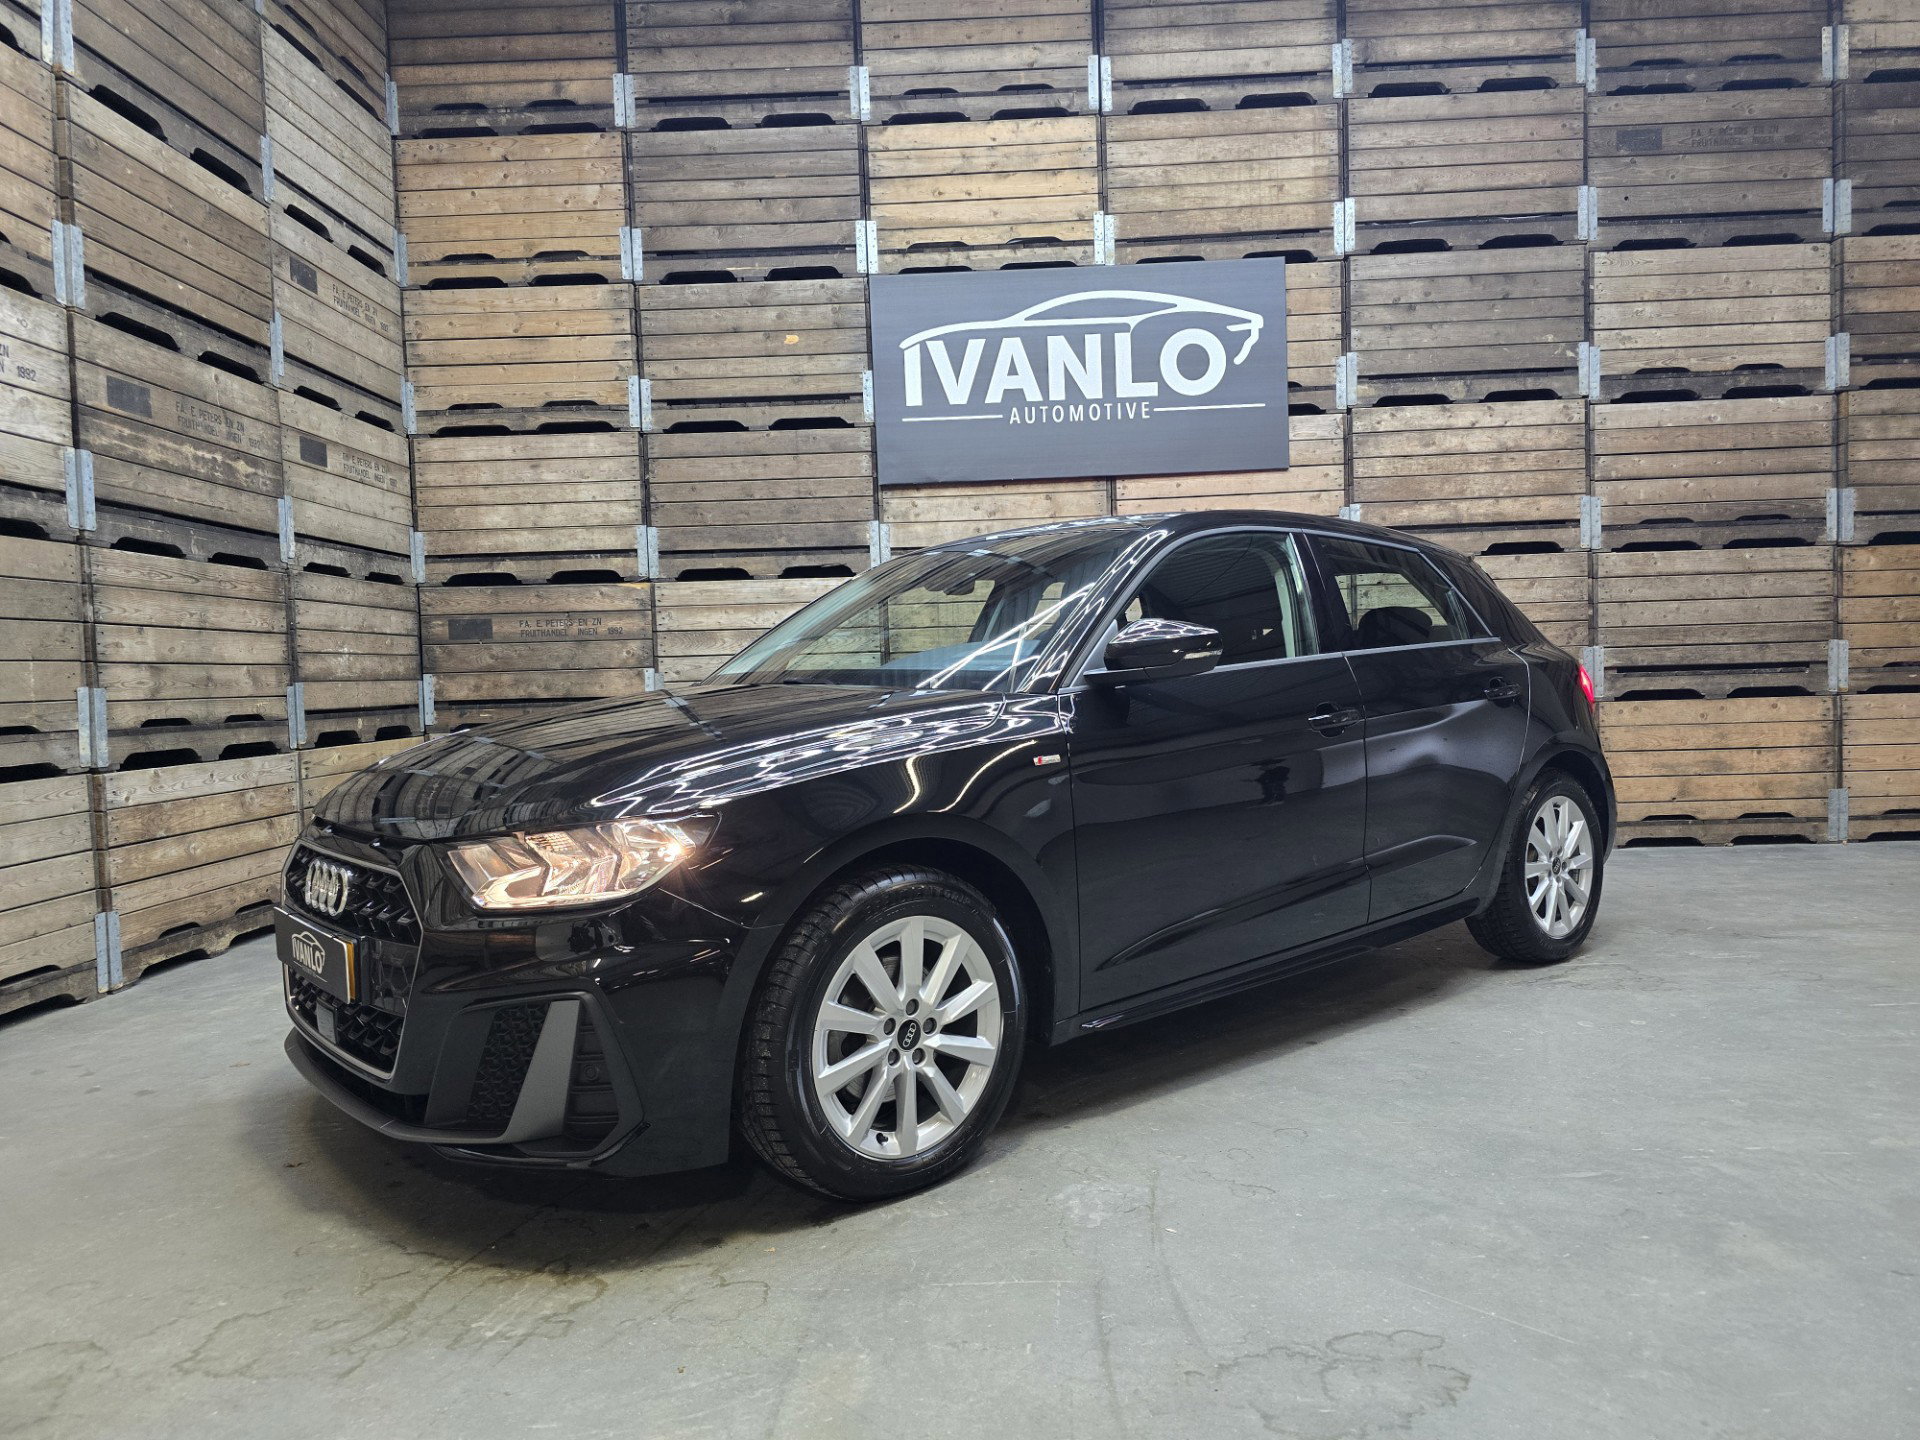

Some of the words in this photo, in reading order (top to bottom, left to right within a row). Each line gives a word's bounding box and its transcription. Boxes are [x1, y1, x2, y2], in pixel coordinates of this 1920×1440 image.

[16, 365, 37, 382] 1992
[903, 328, 1227, 407] IVANLO
[1009, 402, 1150, 425] AUTOMOTIVE
[520, 628, 569, 638] FRUITHANDEL
[577, 627, 598, 636] INGEN
[545, 618, 574, 628] PETERS
[578, 618, 588, 627] EN
[592, 617, 602, 626] ZN
[292, 936, 323, 974] IVANLO
